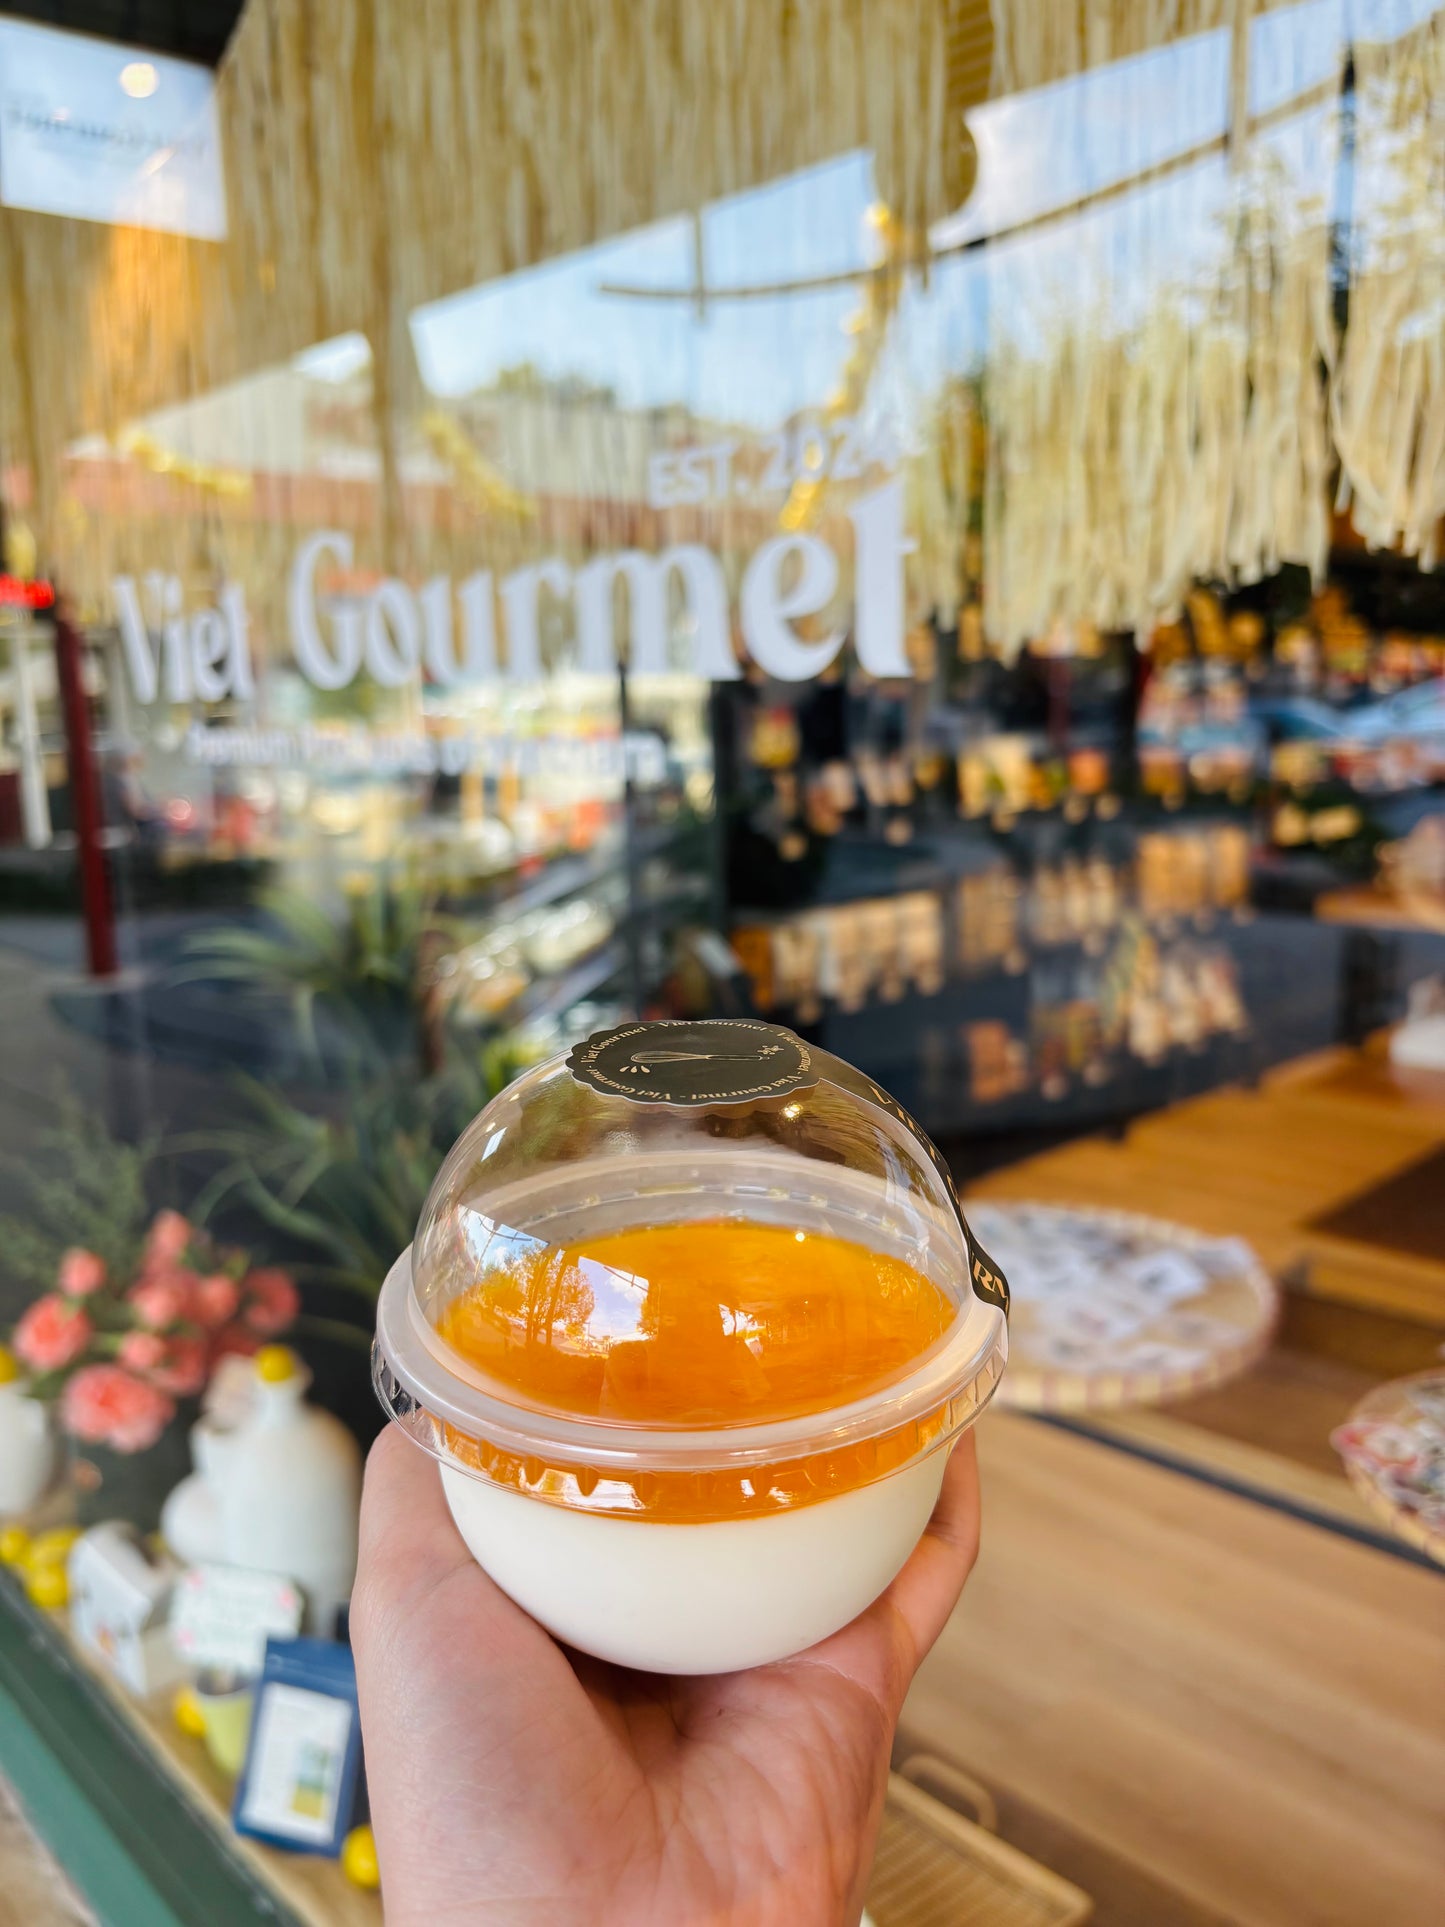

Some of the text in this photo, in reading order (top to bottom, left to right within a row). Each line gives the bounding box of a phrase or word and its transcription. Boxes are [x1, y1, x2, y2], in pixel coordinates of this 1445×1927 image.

[113, 478, 921, 705] Viet Gourmet
[590, 1026, 648, 1052] Gourmet
[585, 1069, 636, 1094] Gourmet
[691, 1085, 773, 1100] Gourmet
